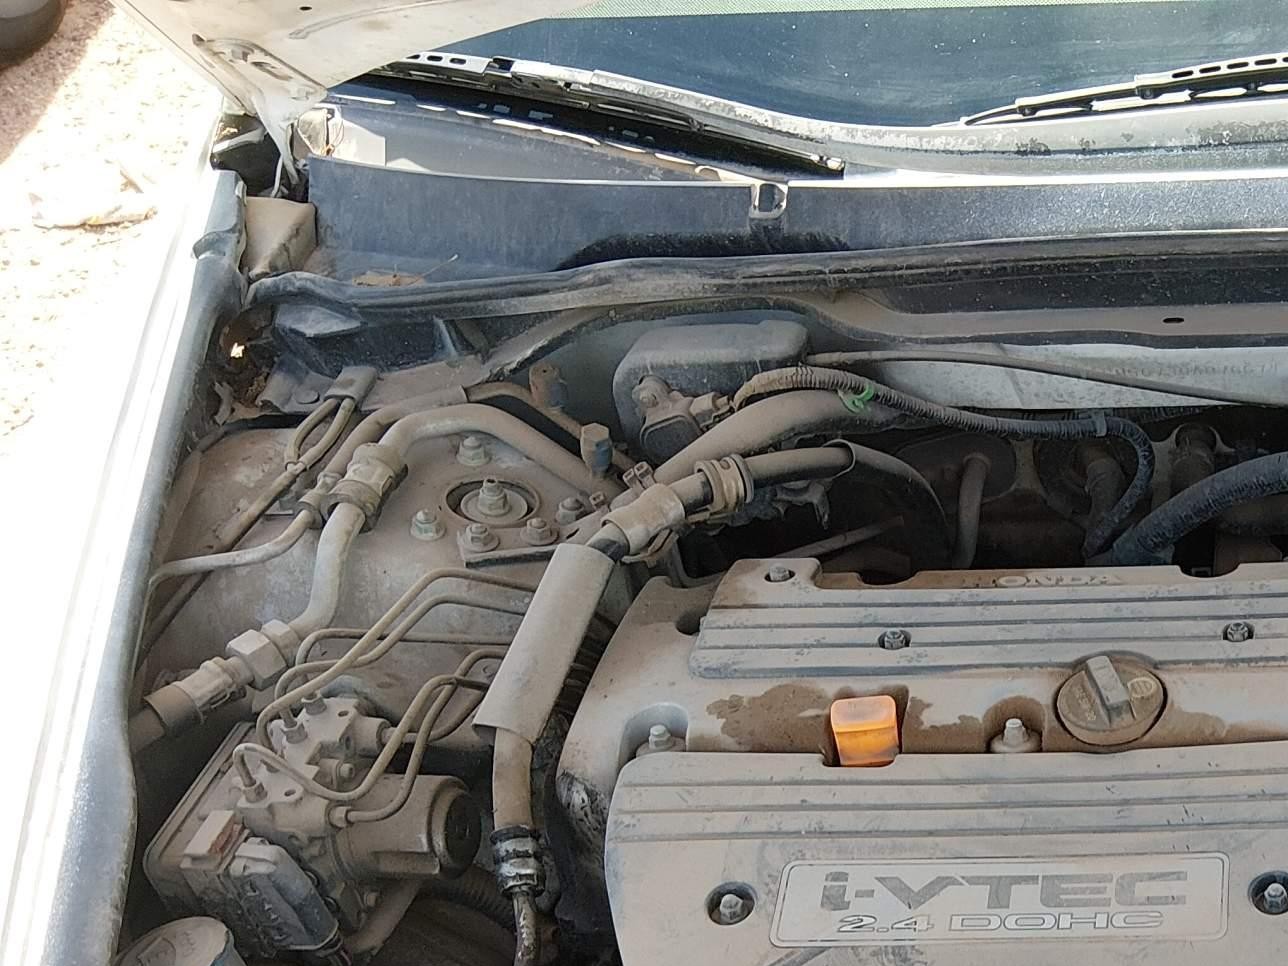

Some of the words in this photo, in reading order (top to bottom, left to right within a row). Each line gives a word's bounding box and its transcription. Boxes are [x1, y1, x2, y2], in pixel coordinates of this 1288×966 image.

[962, 575, 1124, 589] HONDA
[820, 871, 1188, 913] i-VTEC
[836, 914, 935, 934] 2.4
[948, 911, 1165, 933] DOHC
